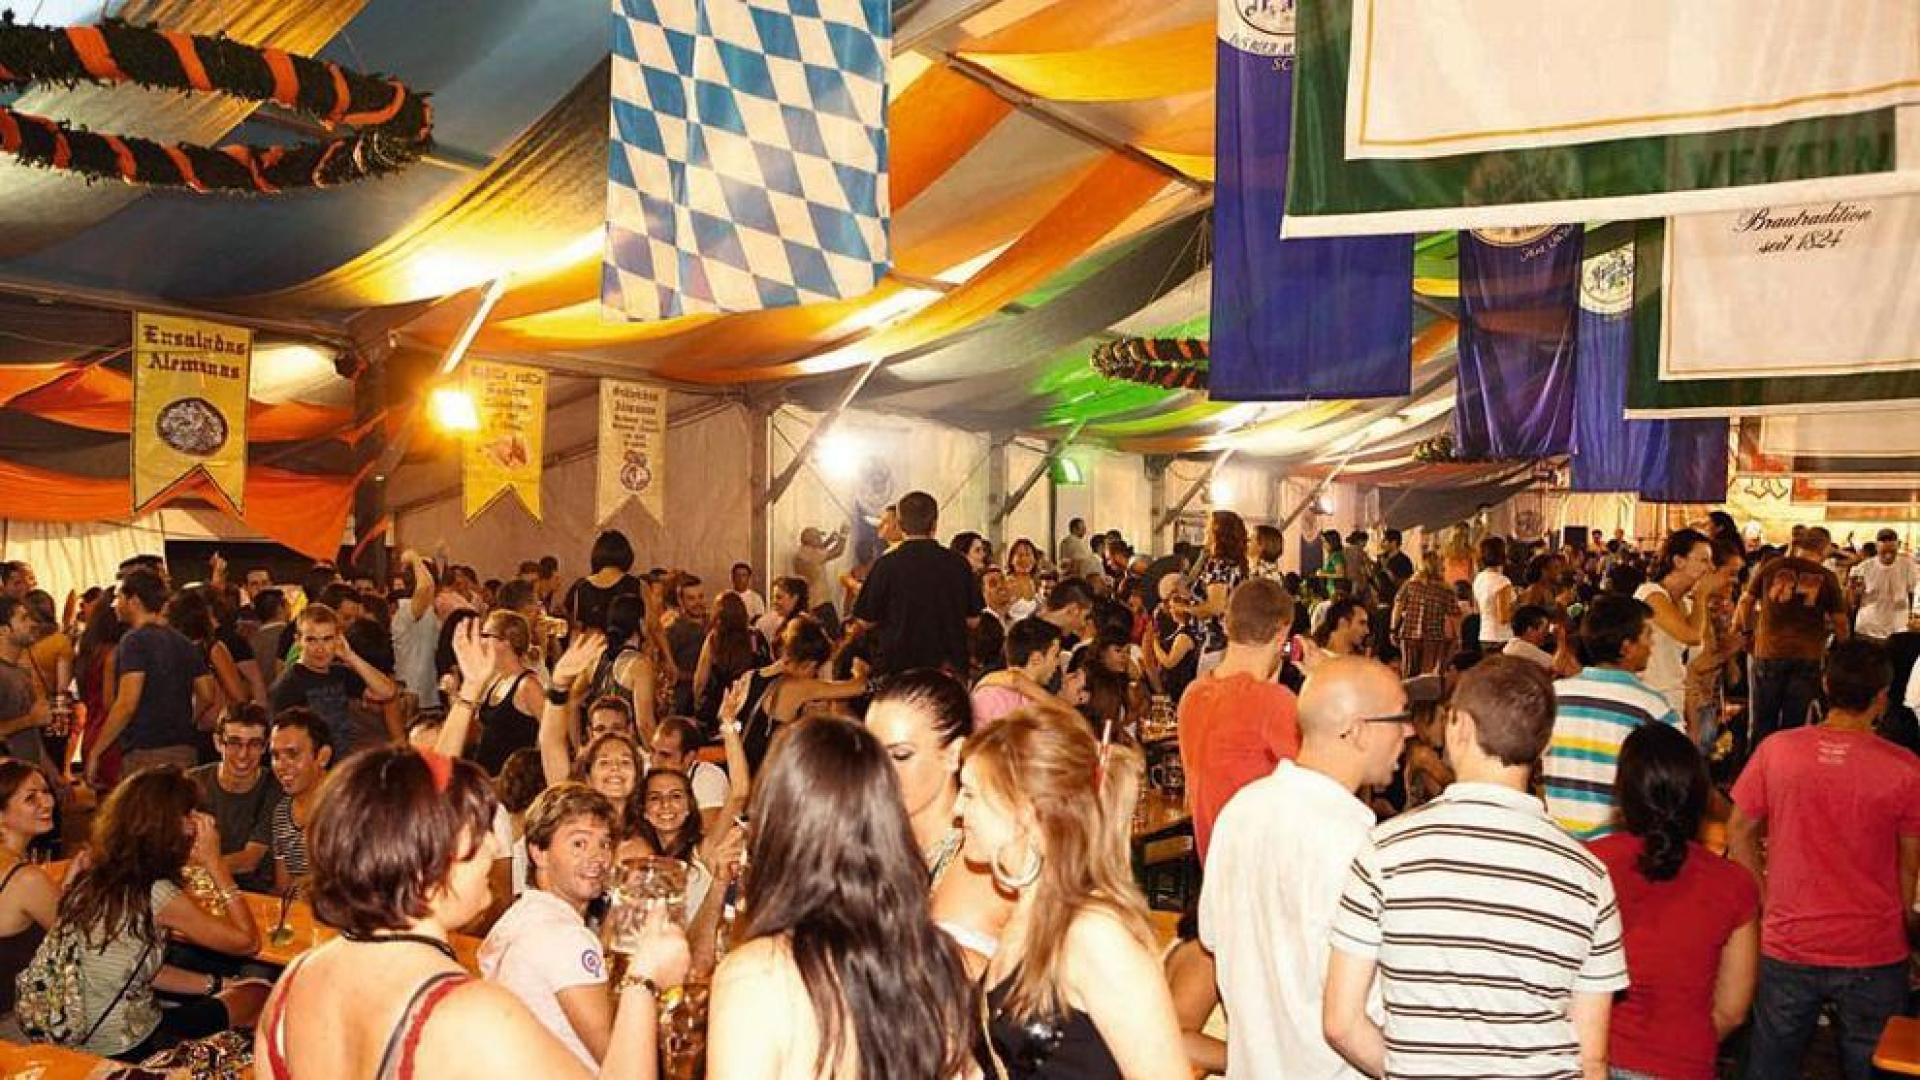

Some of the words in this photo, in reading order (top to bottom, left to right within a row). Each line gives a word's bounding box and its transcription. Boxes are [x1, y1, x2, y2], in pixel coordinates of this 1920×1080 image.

[1733, 201, 1872, 231] Brautradition
[1759, 233, 1794, 253] seit
[1796, 228, 1844, 250] 1824
[143, 325, 246, 355] Ensaladas
[147, 352, 241, 378] Alemanas
